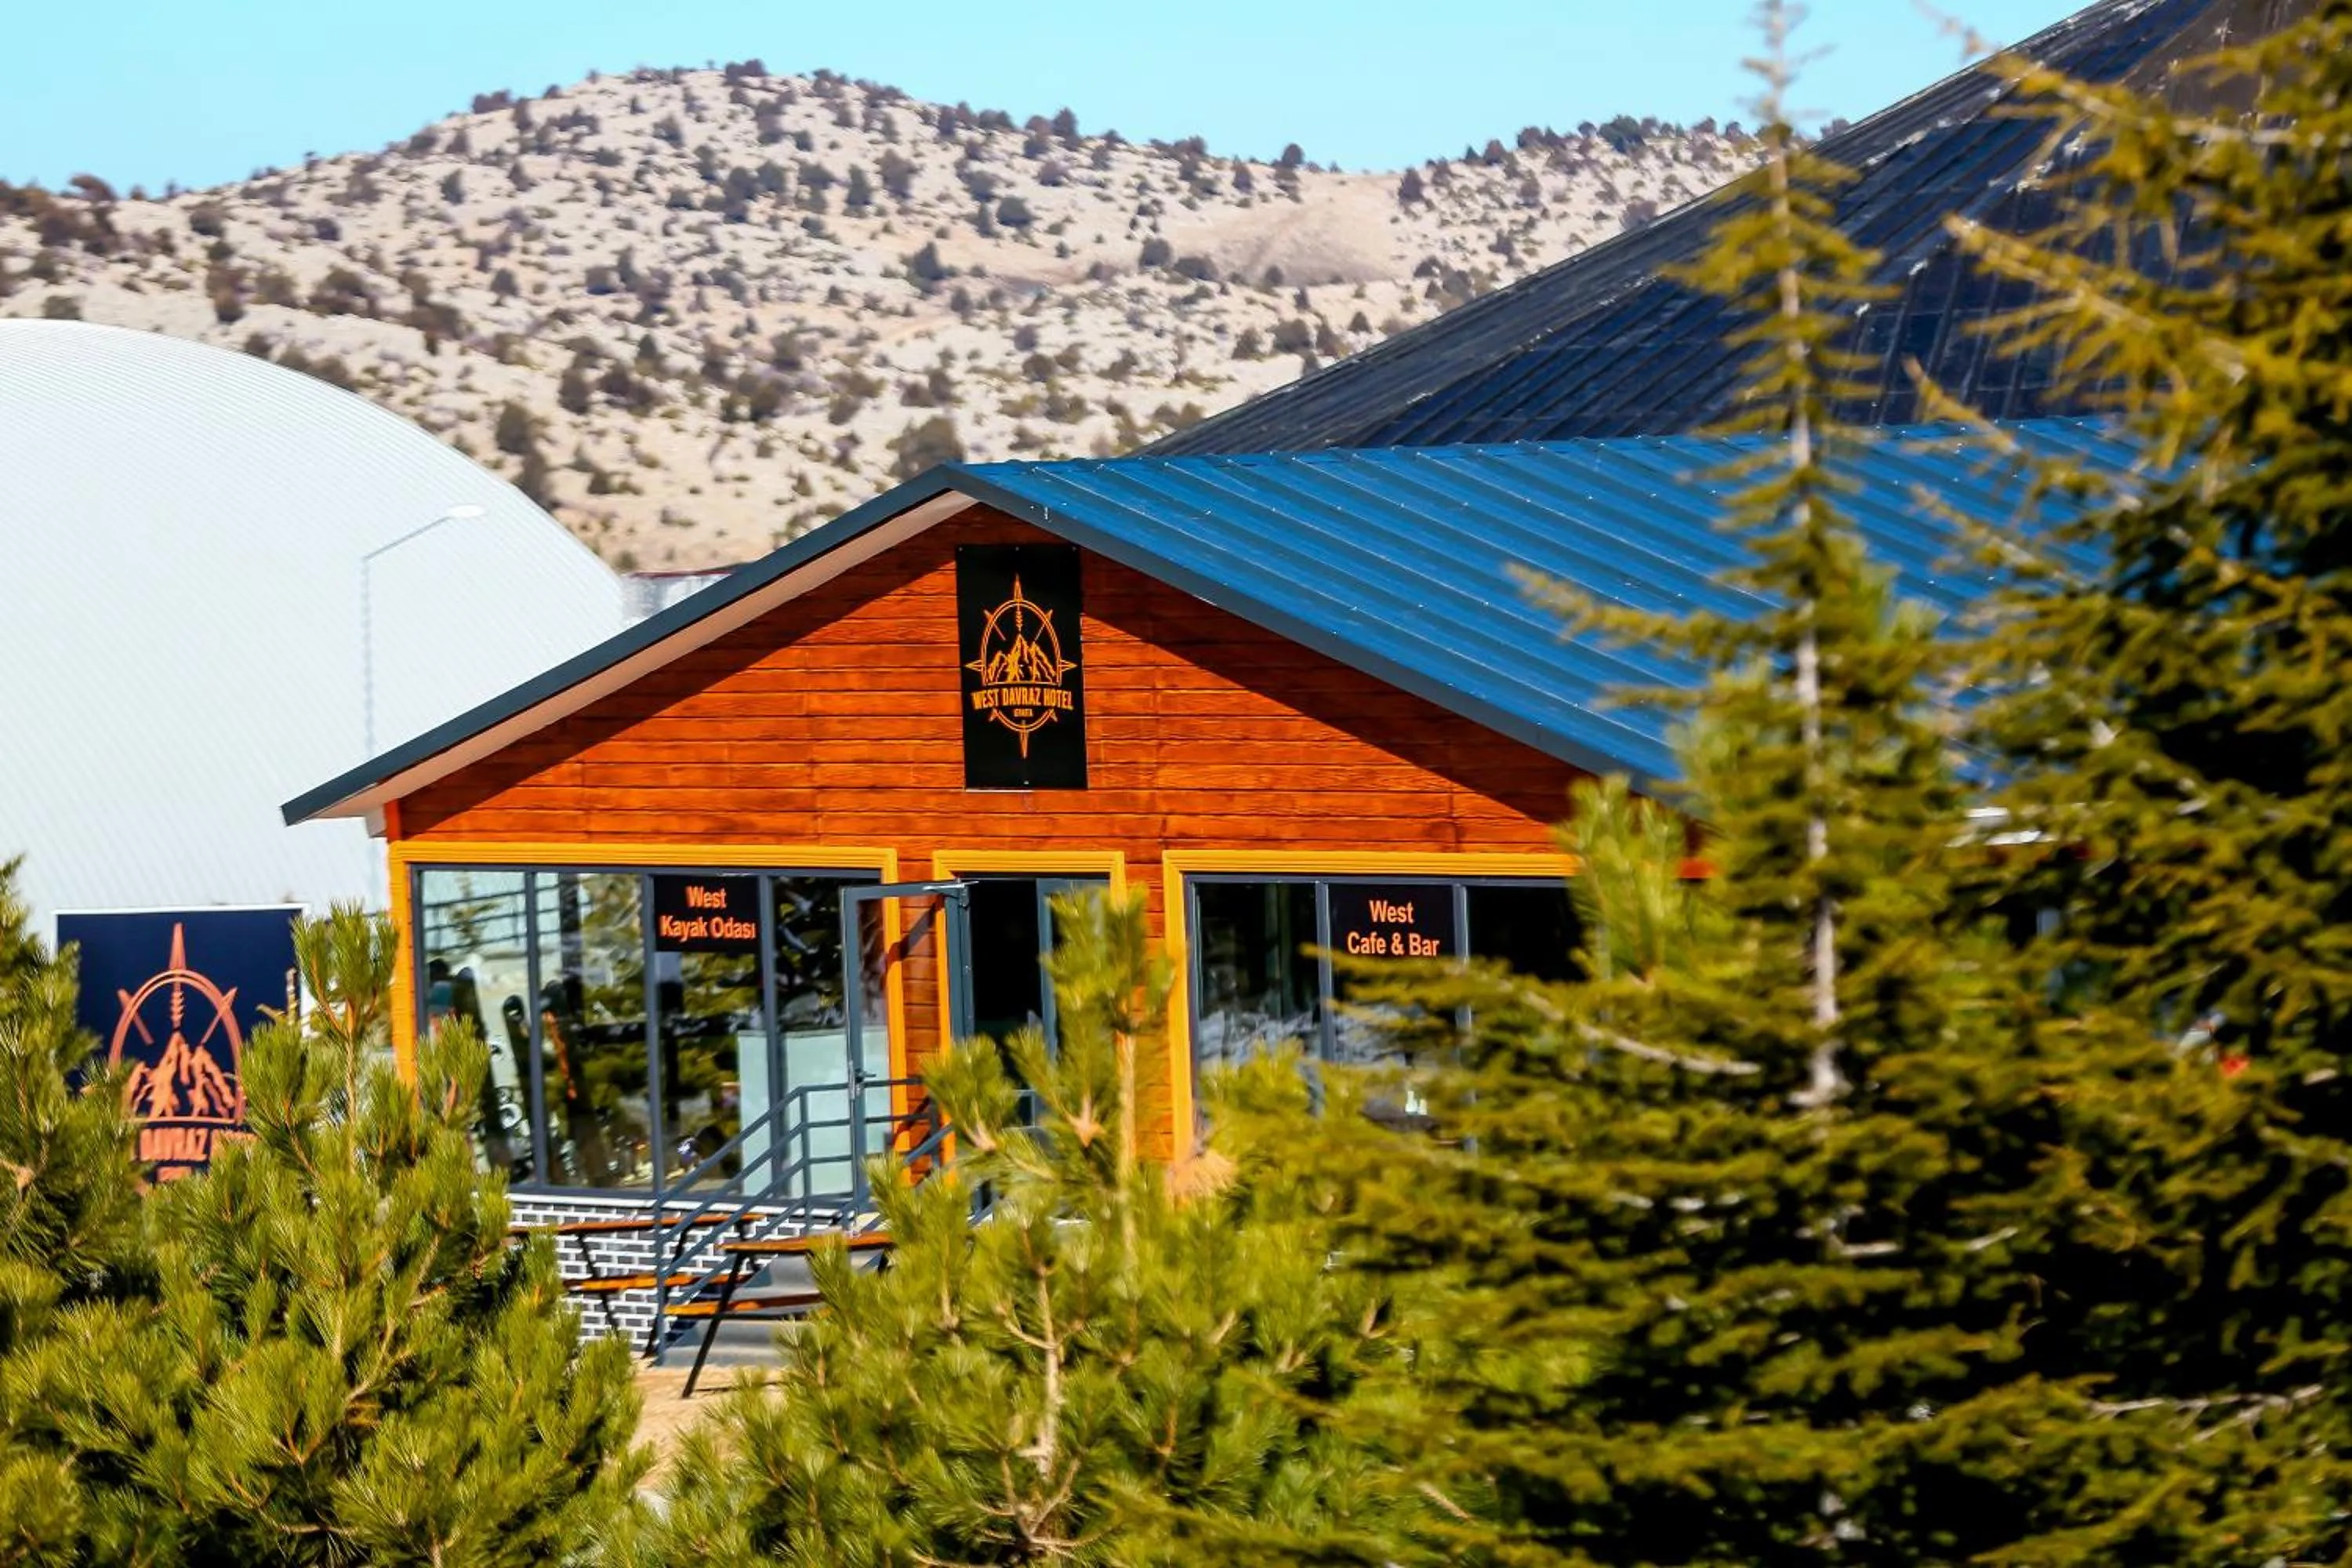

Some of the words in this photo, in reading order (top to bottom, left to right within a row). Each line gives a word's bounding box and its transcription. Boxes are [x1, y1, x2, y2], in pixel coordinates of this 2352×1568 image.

[971, 689, 999, 710] WEST
[1002, 687, 1041, 706] DAVRAZ
[1044, 688, 1073, 710] HOTEL
[685, 885, 727, 909] West
[1369, 899, 1414, 924] West
[660, 915, 708, 942] Kayak
[710, 916, 756, 938] Odası
[1348, 931, 1386, 954] Cafe
[1391, 932, 1404, 955] &
[1409, 932, 1440, 956] Bar
